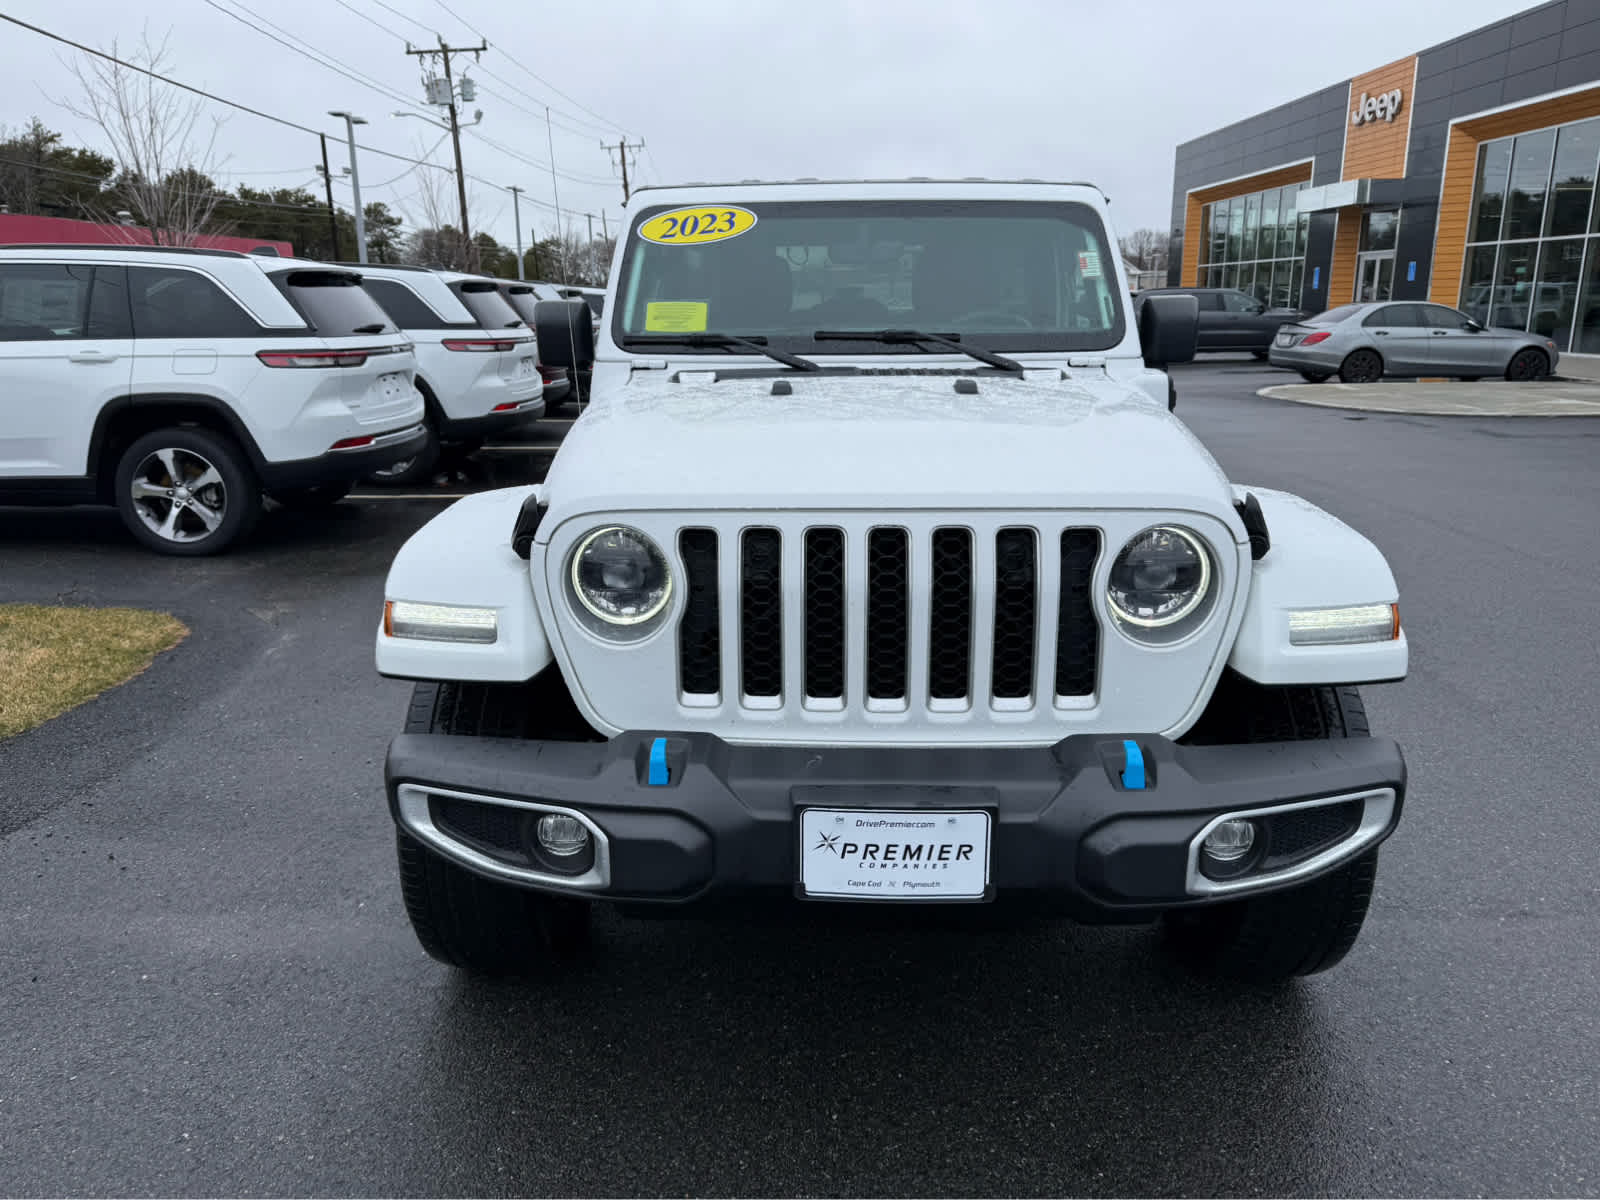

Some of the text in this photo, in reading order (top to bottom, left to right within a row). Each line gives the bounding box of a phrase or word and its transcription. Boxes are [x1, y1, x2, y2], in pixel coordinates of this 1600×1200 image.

[1352, 88, 1402, 125] Jeep
[660, 211, 737, 239] 2023
[855, 819, 936, 829] DrivePremier.com
[840, 843, 974, 860] PREMIER
[847, 879, 941, 889] Cape Cod Plymouth
